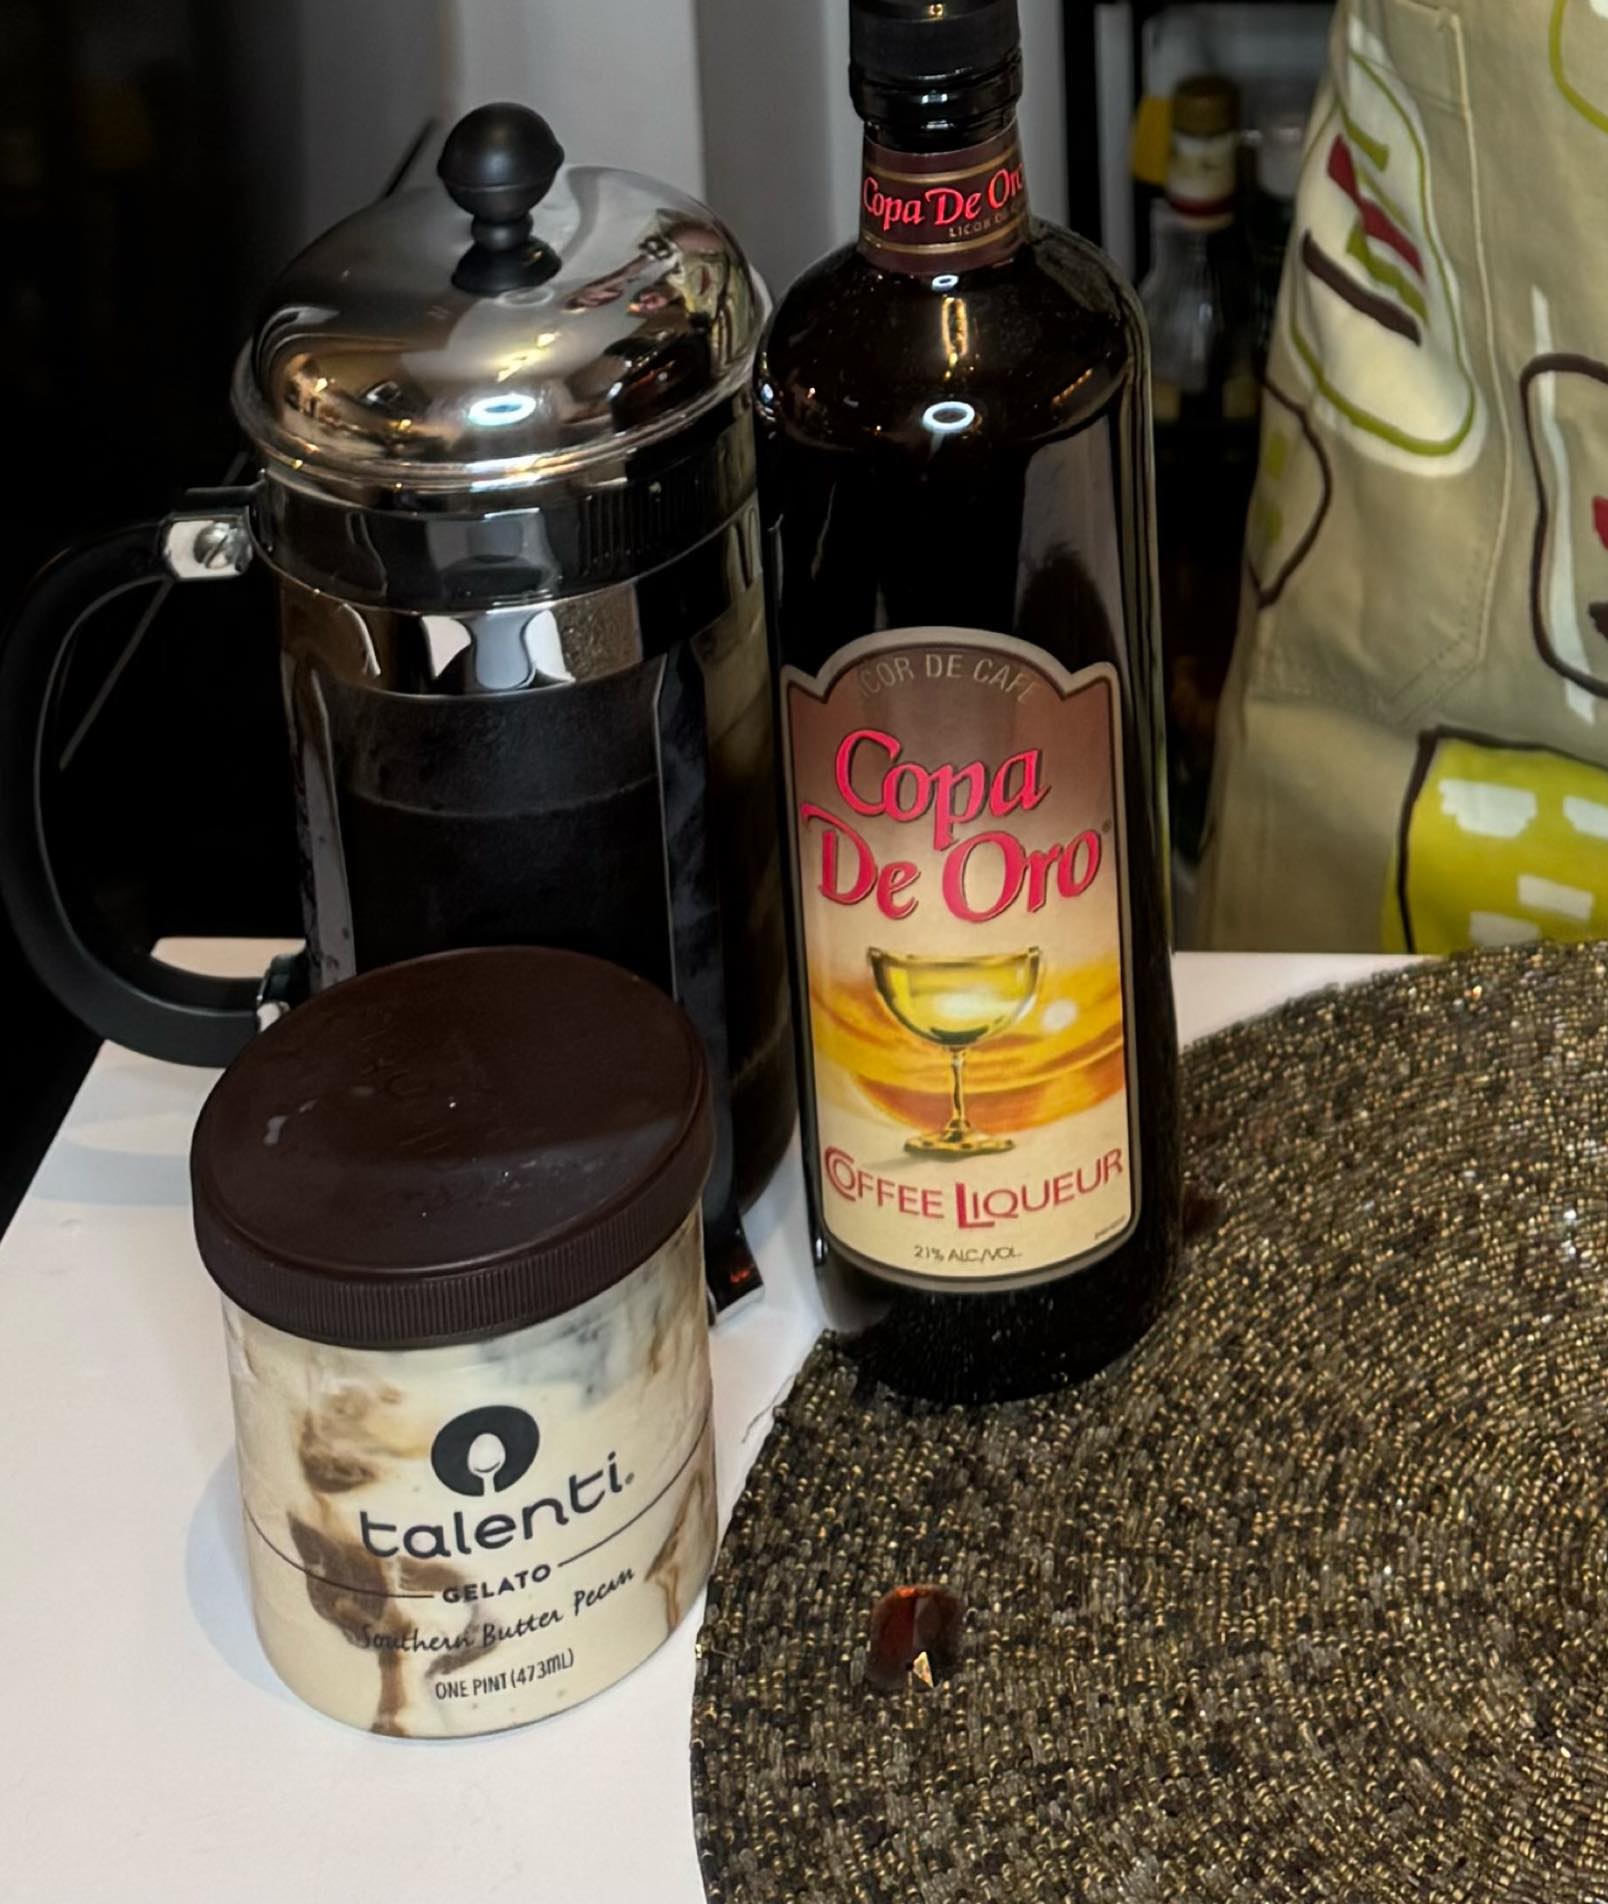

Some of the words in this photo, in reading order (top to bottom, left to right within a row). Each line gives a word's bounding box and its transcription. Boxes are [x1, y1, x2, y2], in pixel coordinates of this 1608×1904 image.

[863, 176, 926, 232] Copa
[925, 187, 983, 226] De
[925, 653, 964, 678] DE
[834, 728, 1052, 852] Copa
[801, 799, 921, 921] De
[824, 1146, 945, 1219] COFFEE
[954, 1147, 1124, 1229] LIQUEUR
[360, 1622, 474, 1652] Southern
[482, 1611, 564, 1649] Butter
[573, 1567, 635, 1616] Pecan
[442, 1563, 552, 1604] GELATO
[435, 1681, 469, 1700] ONE
[472, 1672, 507, 1696] PINT
